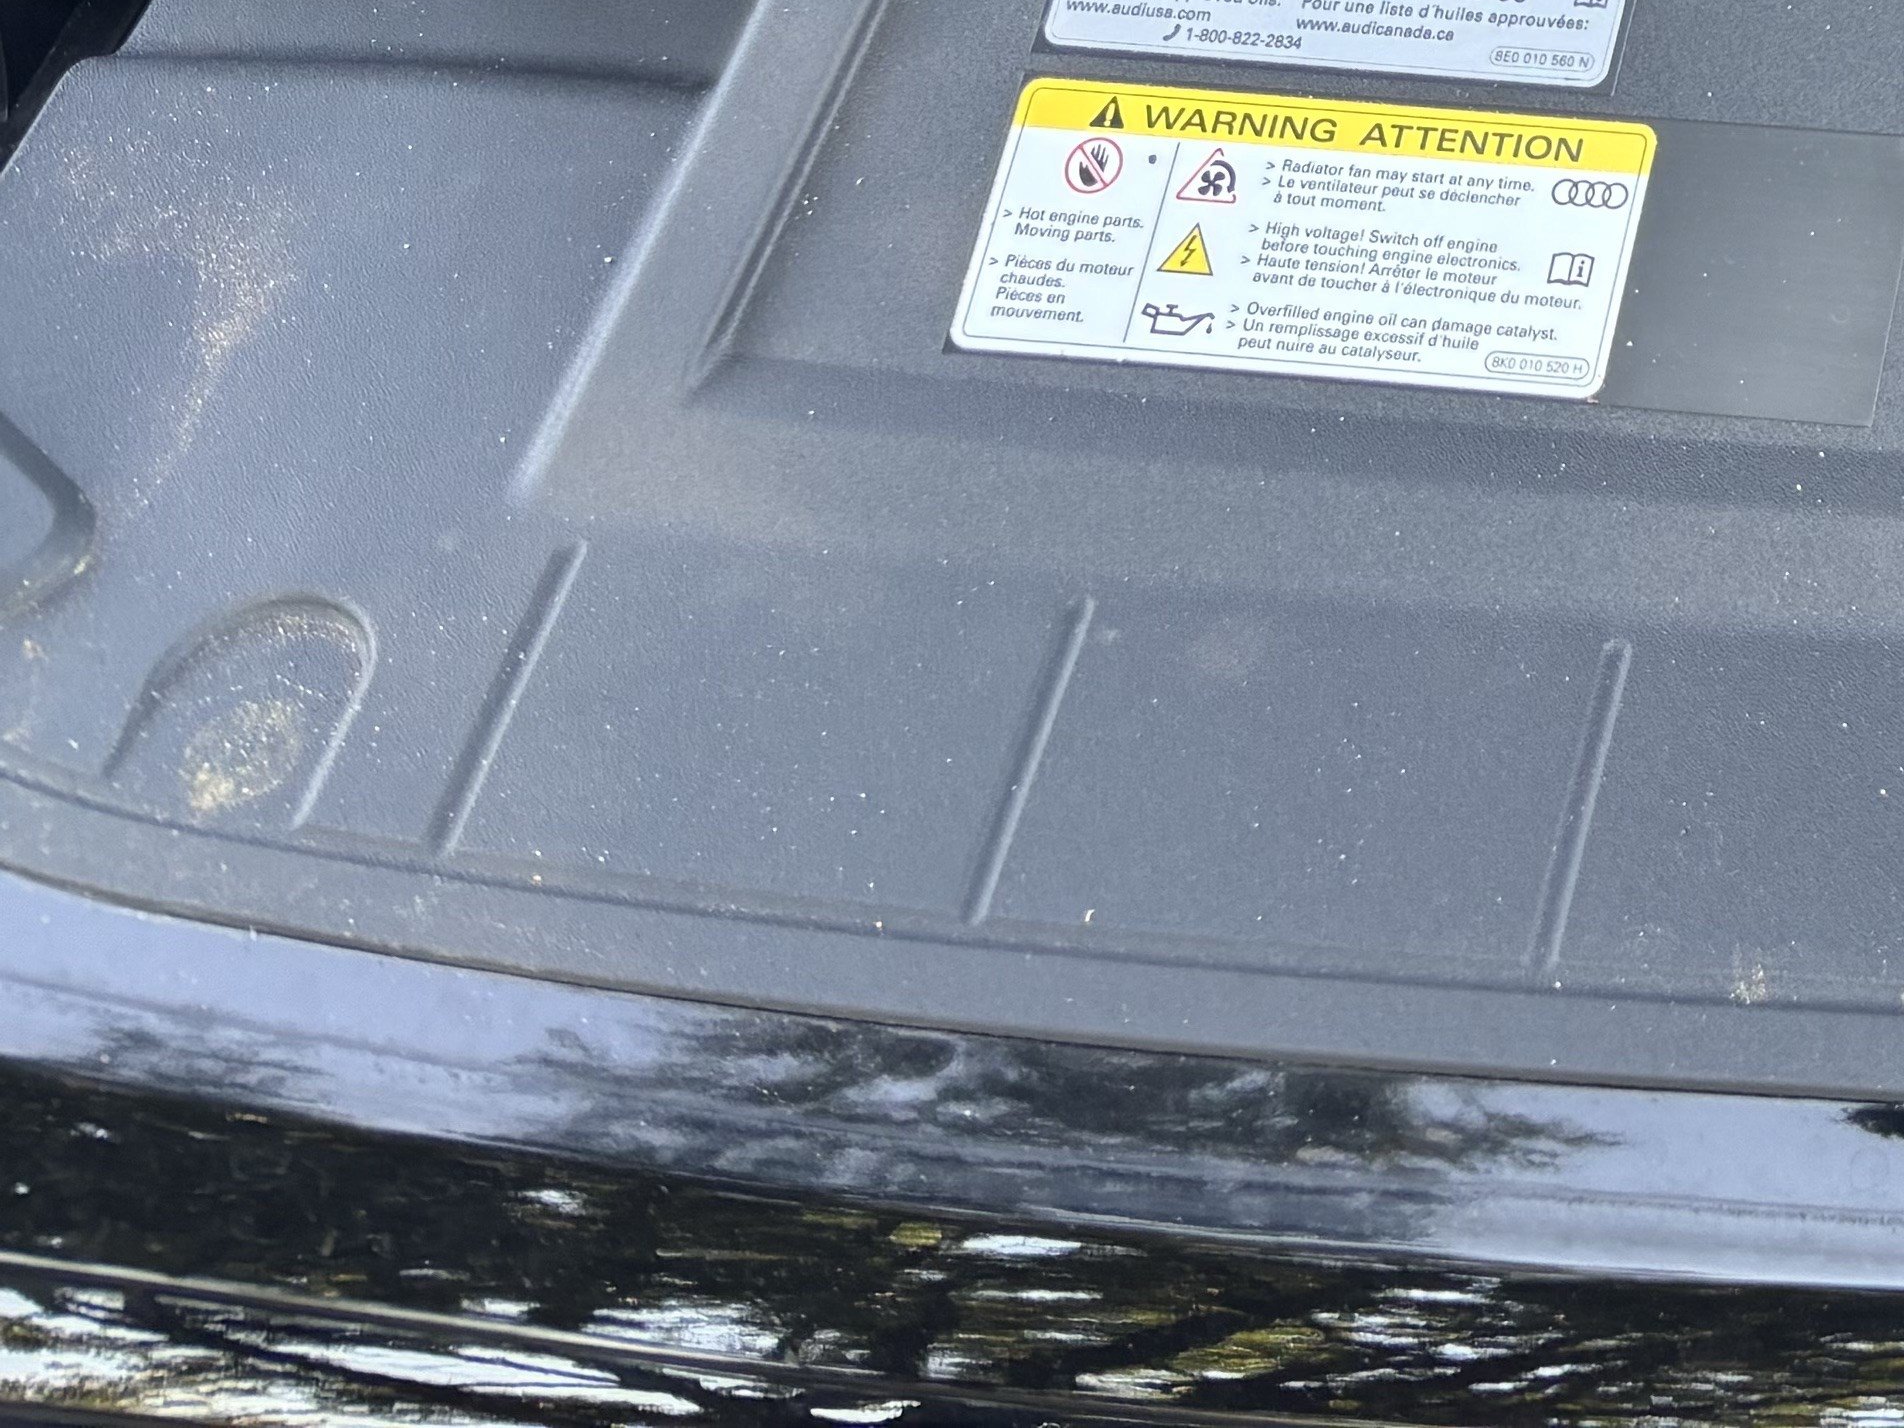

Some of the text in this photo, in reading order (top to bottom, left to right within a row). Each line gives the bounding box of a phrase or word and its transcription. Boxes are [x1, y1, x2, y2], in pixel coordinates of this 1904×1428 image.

[1066, 0, 1211, 22] www.audiusa.com
[1343, 0, 1374, 14] une
[1378, 0, 1413, 17] liste
[1186, 26, 1302, 49] 1-800-822-2834
[1522, 52, 1547, 65] 010
[1550, 53, 1575, 67] 560
[1578, 55, 1589, 68] N
[1145, 103, 1583, 162] WARNING ATTENTION
[1281, 158, 1534, 192] Radiator fan may start at any time.
[1277, 174, 1295, 188] Le
[1299, 179, 1378, 194] ventilateur
[1380, 185, 1415, 198] peut
[1417, 188, 1435, 200] se
[1286, 192, 1316, 207] tout
[1319, 197, 1385, 212] moment.
[1018, 206, 1144, 228] Hot engine parts.
[1013, 221, 1115, 242] Moving parts.
[1264, 220, 1498, 254] High voltage! Switch off engine
[1260, 237, 1520, 271] before touching engine electronics.
[1055, 257, 1075, 272] du
[1078, 262, 1134, 276] moteur
[1256, 252, 1300, 269] Haute
[1304, 258, 1366, 274] tension!
[1424, 266, 1438, 280] le
[1442, 271, 1497, 285] moteur
[999, 271, 1065, 288] chaudes.
[1251, 271, 1294, 285] avant
[1297, 273, 1316, 287] de
[1320, 276, 1377, 292] toucher
[1499, 289, 1520, 304] du
[1523, 294, 1581, 309] moteur.
[1045, 293, 1065, 304] en
[989, 305, 1084, 322] mouvement.
[1246, 300, 1557, 341] Overfilled engine oil can damage catalyst.
[1242, 317, 1264, 332] Un
[1268, 322, 1359, 342] remplissage
[1364, 329, 1426, 347] excessif
[1236, 336, 1421, 362] peut nuire au catalyseur.
[1490, 355, 1582, 374] 8K0 010 520 H
